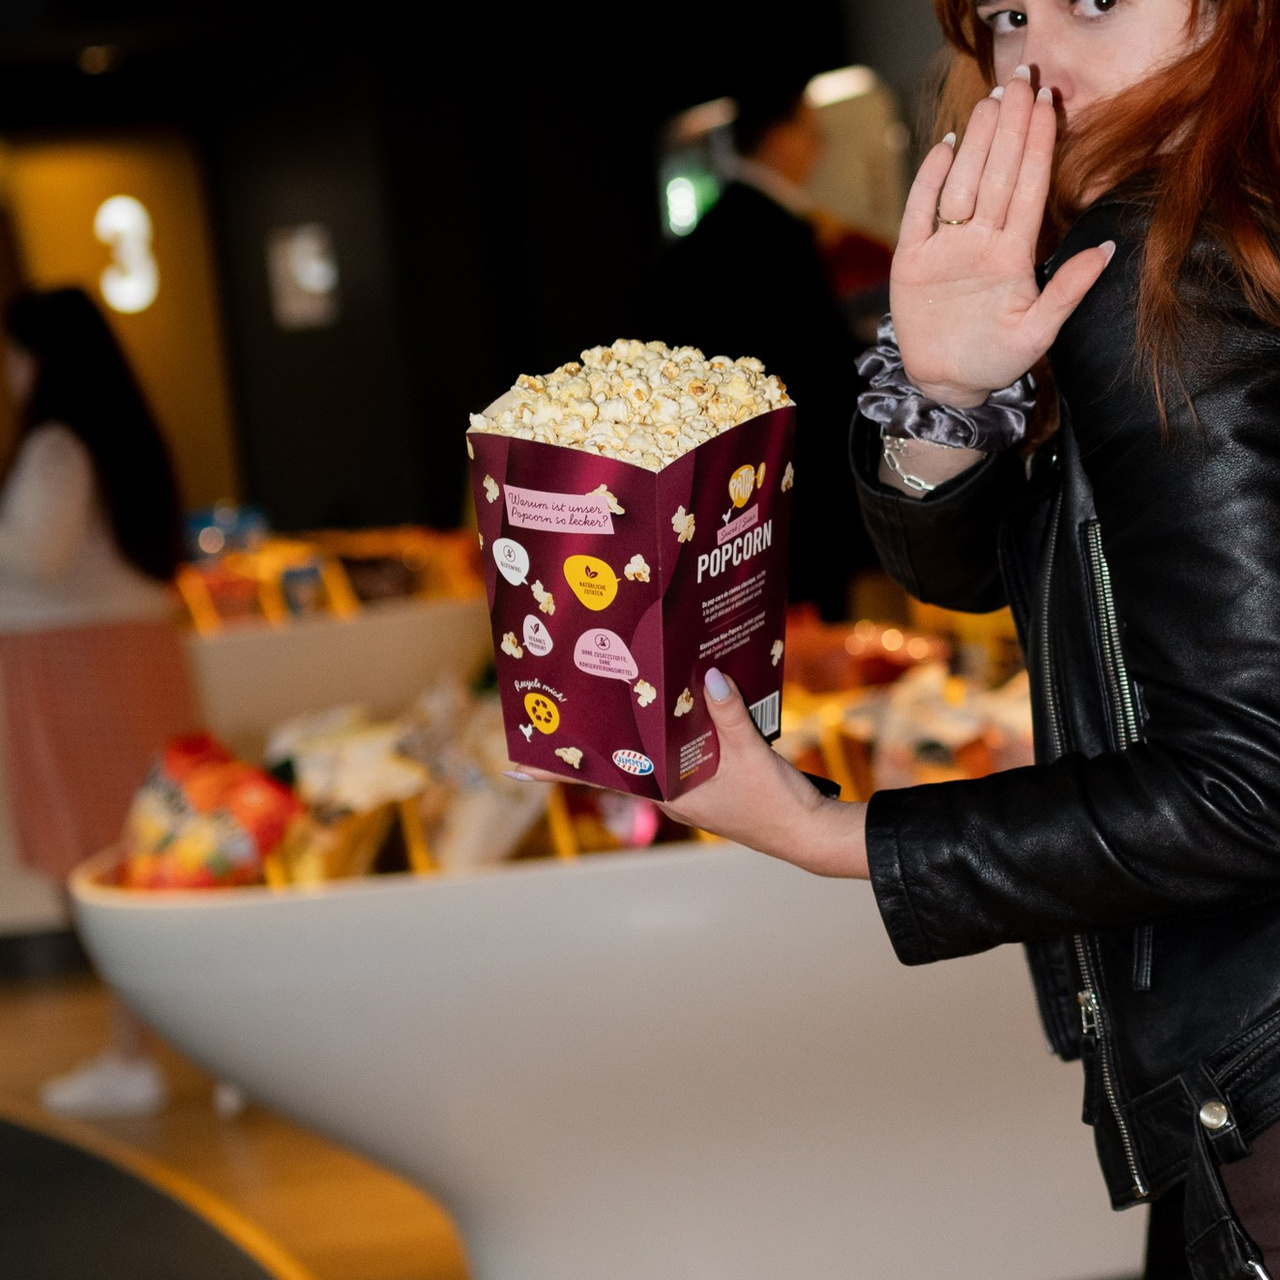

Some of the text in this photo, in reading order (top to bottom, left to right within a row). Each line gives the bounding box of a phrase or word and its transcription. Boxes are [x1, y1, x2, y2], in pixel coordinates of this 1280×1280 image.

[94, 194, 160, 314] 3
[508, 492, 602, 514] Warum ist unser
[511, 506, 609, 528] Popcorn so lecker?
[697, 519, 772, 584] POPCORN
[500, 561, 522, 574] GLUTENFREI
[579, 581, 606, 591] NATÜRLICHE
[583, 588, 604, 597] ZUTATEN
[528, 635, 546, 645] VEGANES
[581, 649, 628, 663] OHNE ZUSATZSTOFFE,
[579, 661, 633, 676] KONSERVIERUNGSMITTEL
[514, 678, 567, 703] Recycle mich!
